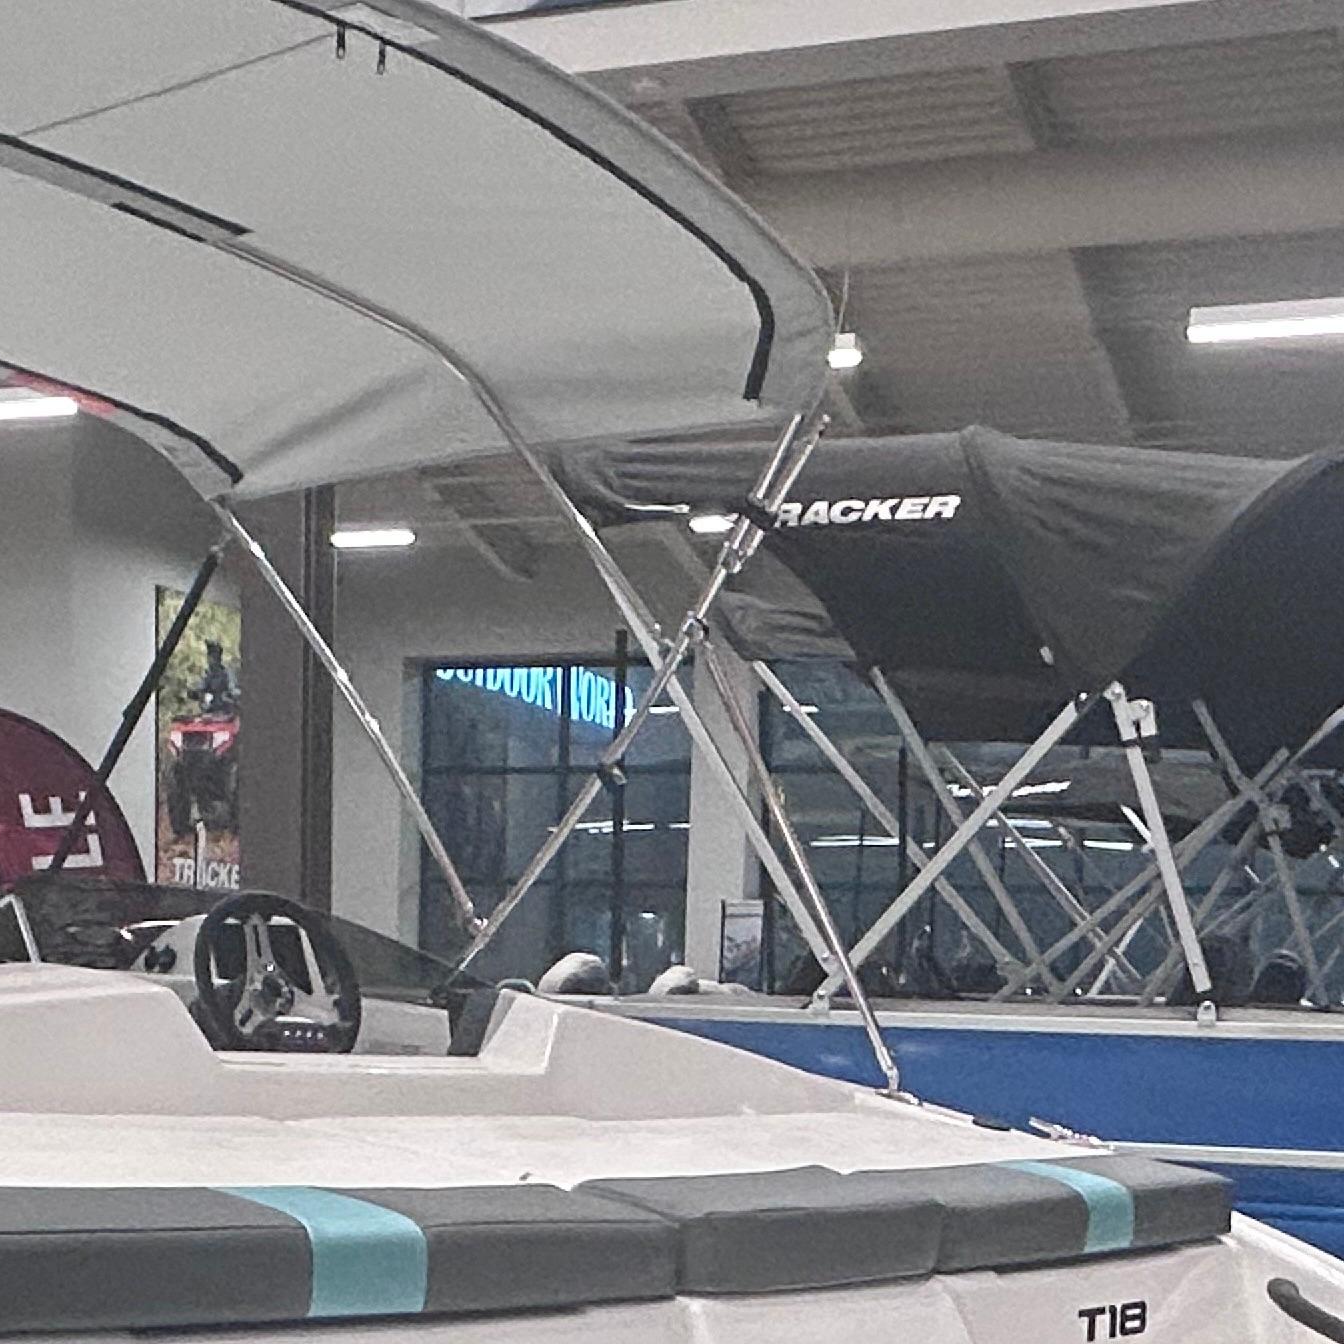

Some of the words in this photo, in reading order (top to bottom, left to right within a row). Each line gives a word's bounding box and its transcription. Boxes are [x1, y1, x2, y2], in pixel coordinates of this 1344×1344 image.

[774, 495, 961, 528] RACKER
[172, 857, 240, 890] TRCKE
[1078, 1300, 1147, 1342] T18
